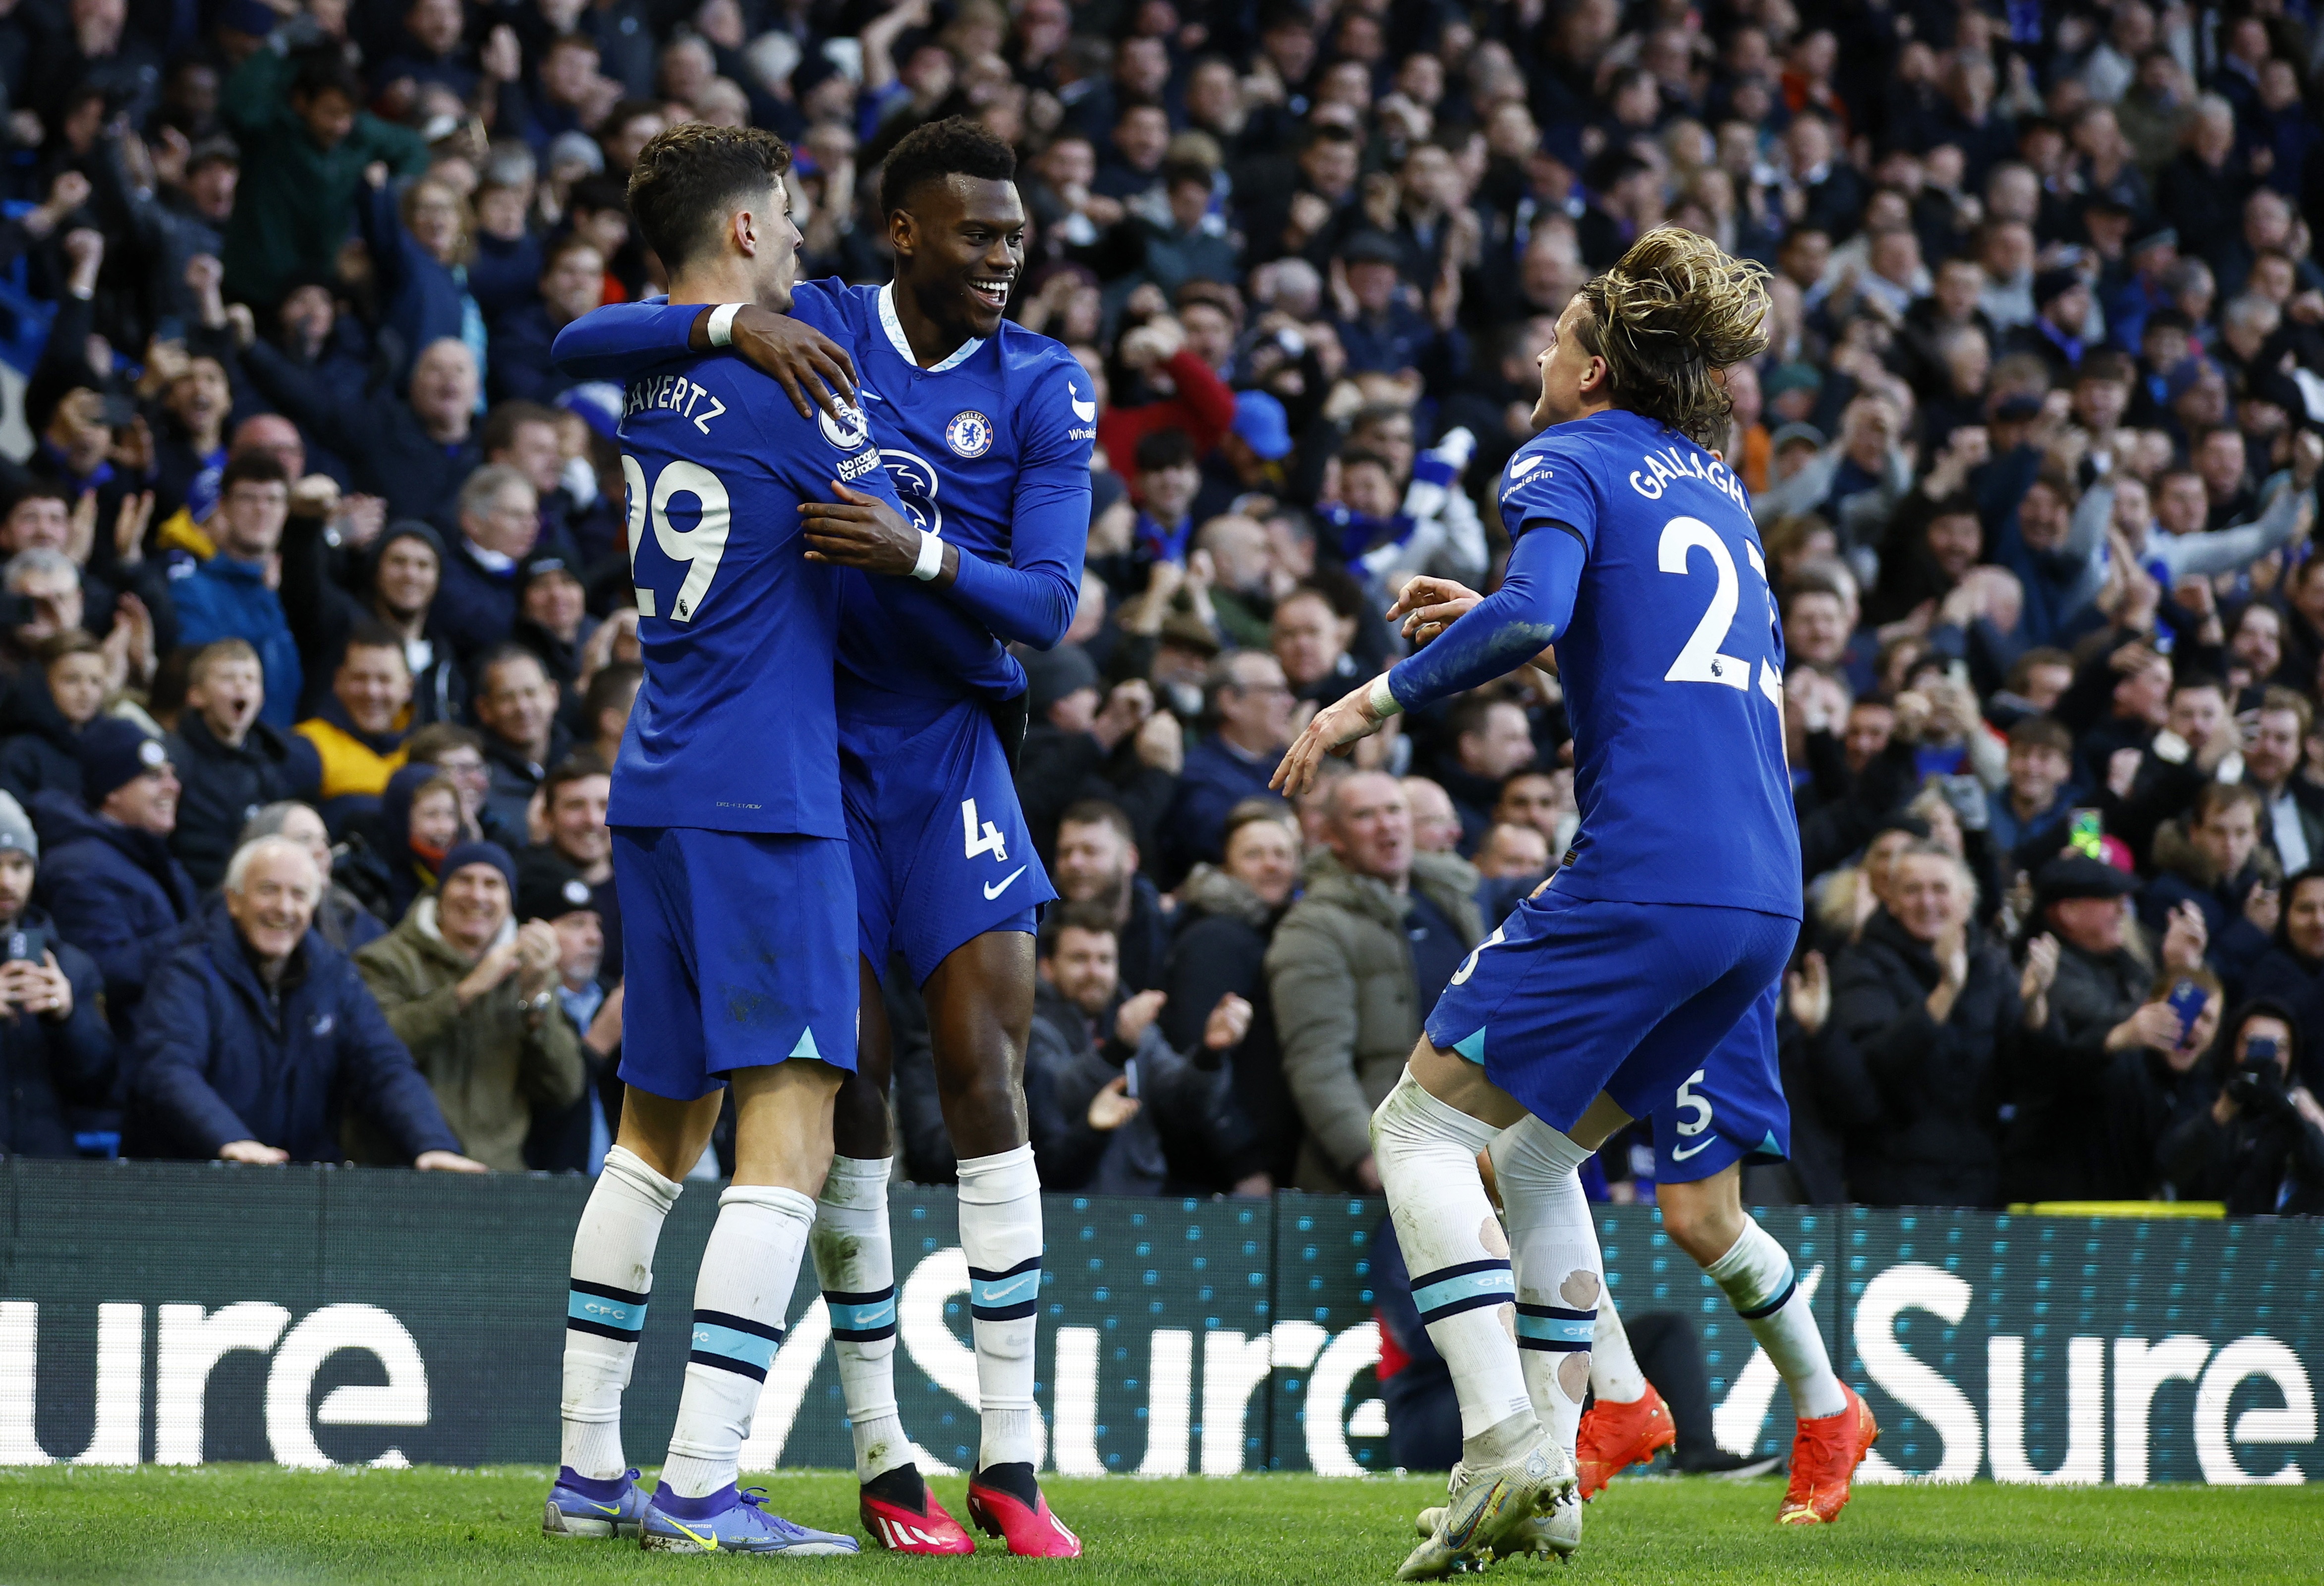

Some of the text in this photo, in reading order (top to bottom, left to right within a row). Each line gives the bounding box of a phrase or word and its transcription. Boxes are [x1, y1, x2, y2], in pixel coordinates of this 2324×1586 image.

[956, 412, 985, 424] CHELSEA
[836, 447, 877, 473] No room
[952, 444, 971, 456] FOOTBALL
[840, 455, 881, 482] for racism
[1502, 470, 1553, 502] WhaleFin
[1629, 446, 1757, 529] GALLAGH
[961, 797, 1009, 863] 4
[1676, 1068, 1713, 1137] 5
[585, 1303, 626, 1320] CFC
[898, 1246, 1390, 1478] Sure
[1853, 1262, 2318, 1486] Sure
